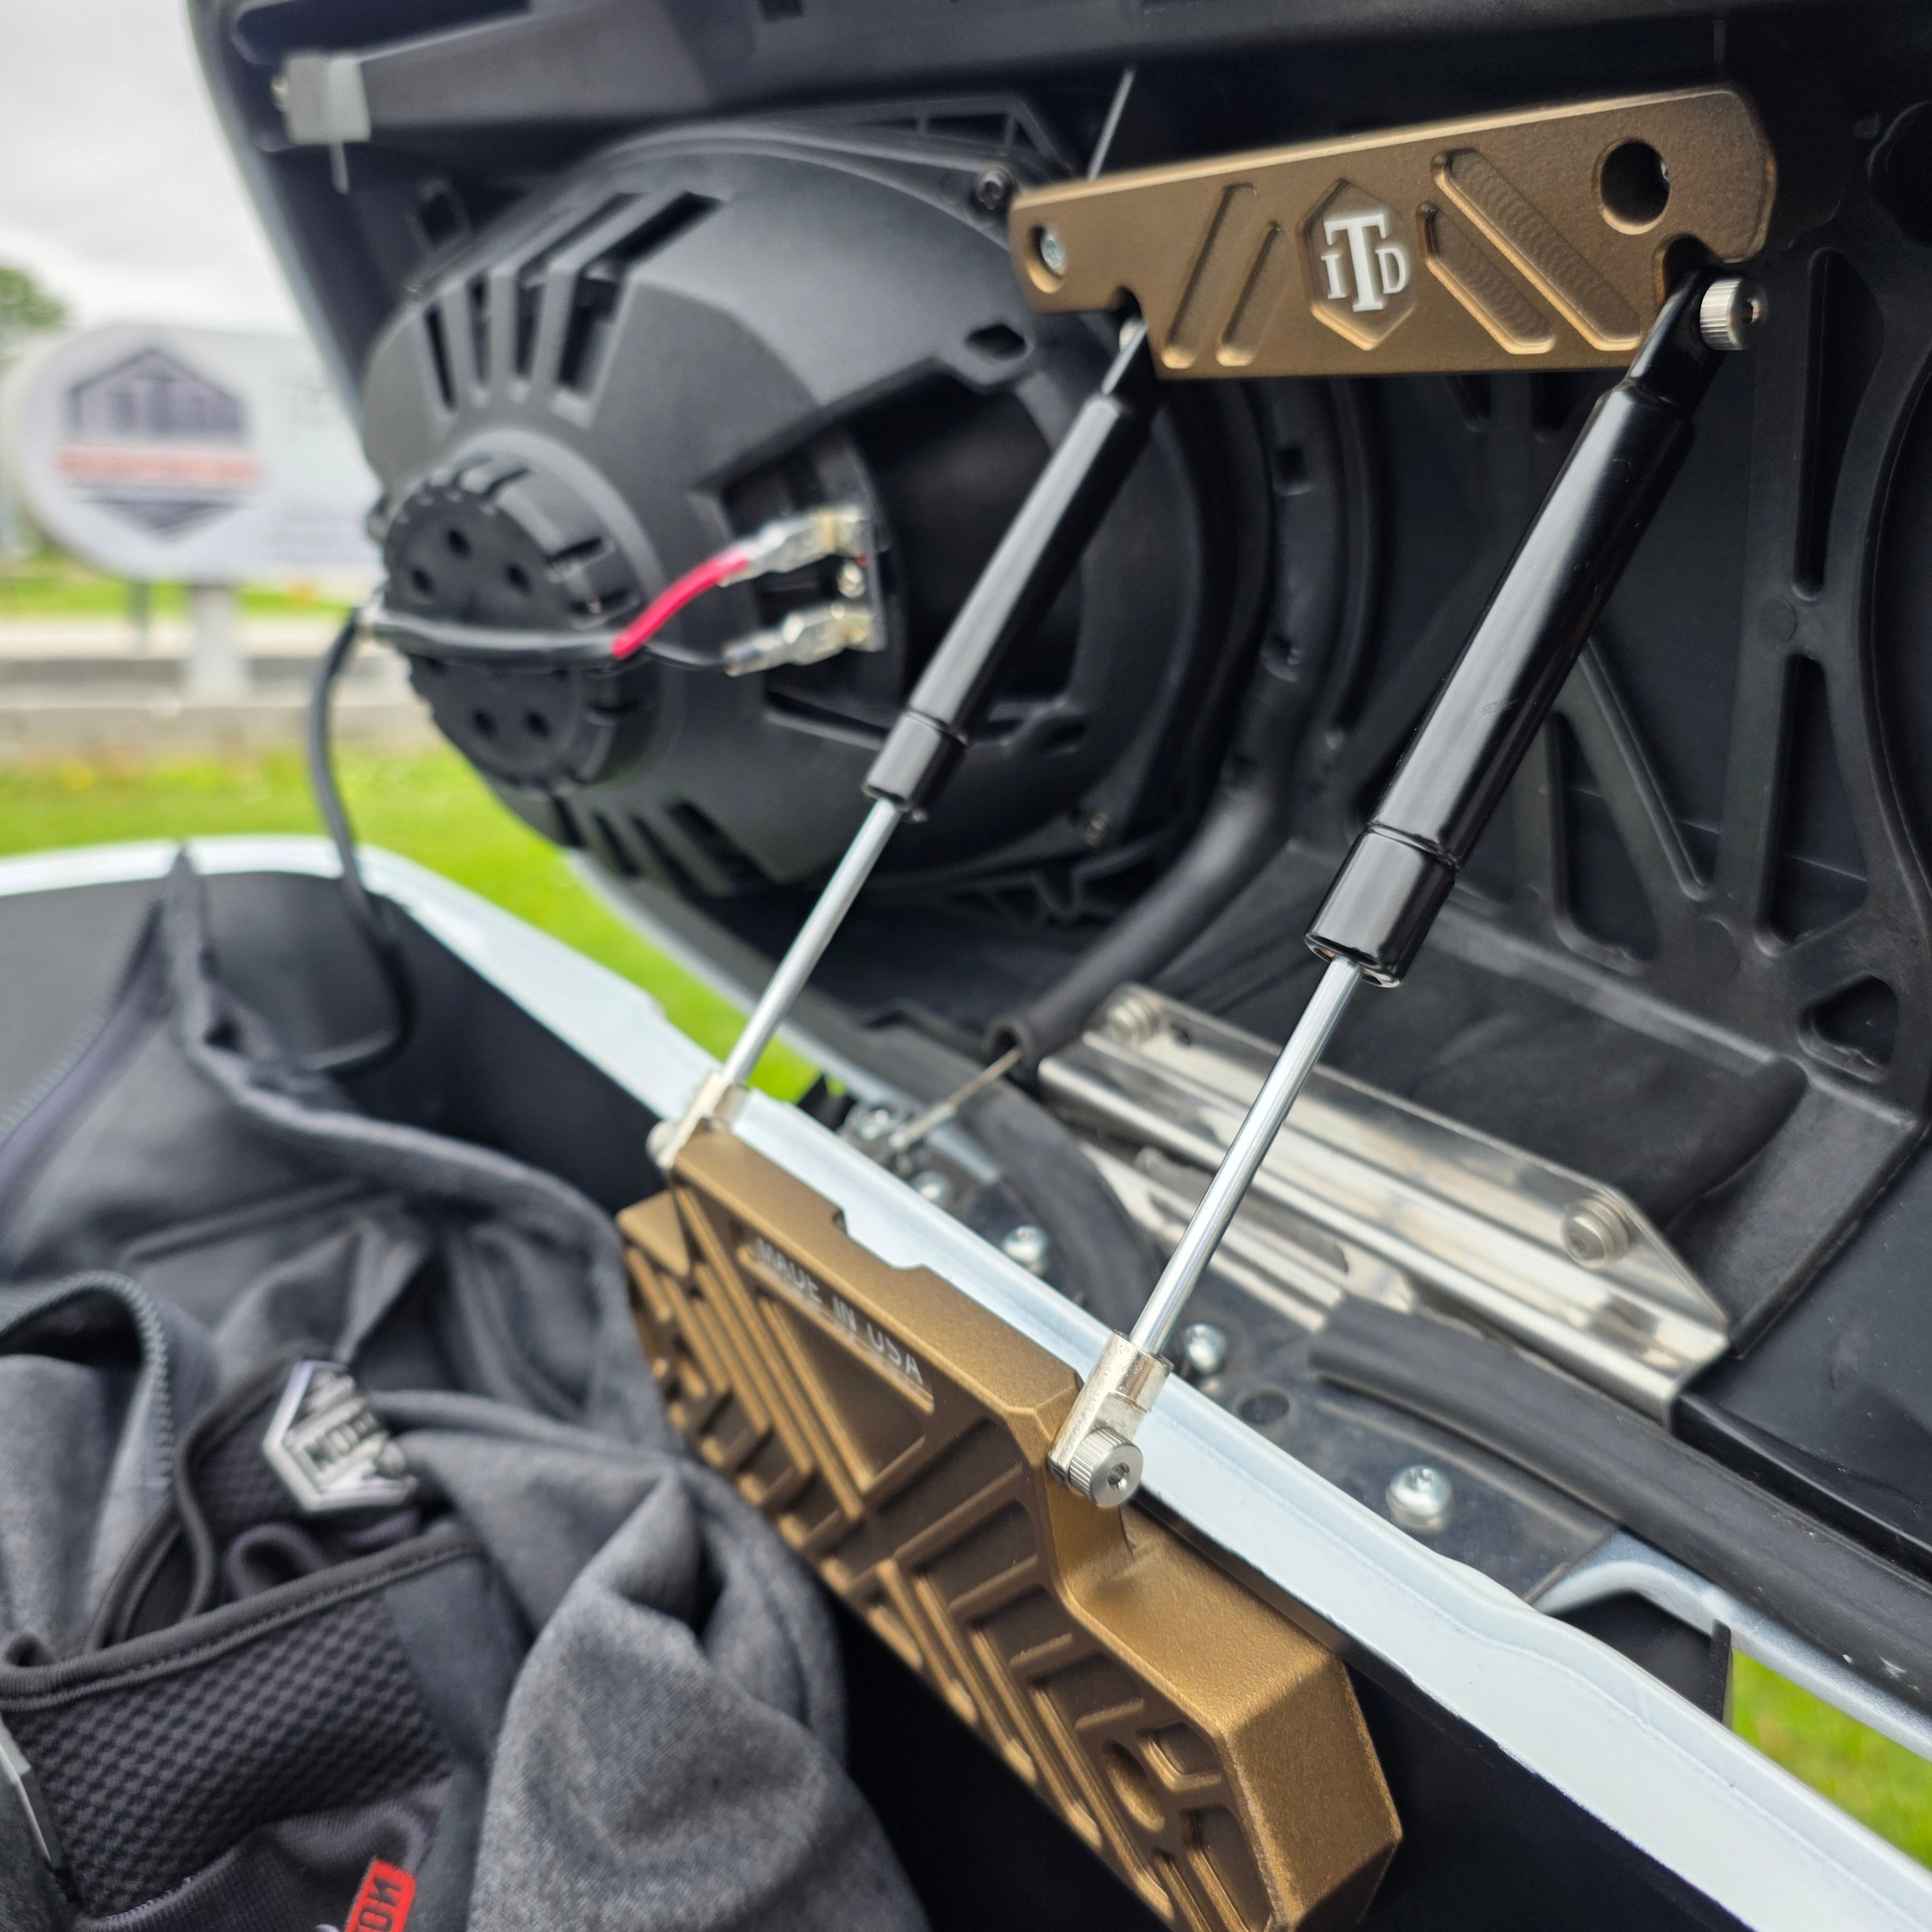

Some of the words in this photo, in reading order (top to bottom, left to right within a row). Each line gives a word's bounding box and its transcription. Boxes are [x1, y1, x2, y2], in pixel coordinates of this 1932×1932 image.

[755, 1236, 823, 1305] MADE
[832, 1295, 858, 1333] IN
[866, 1322, 925, 1386] USA
